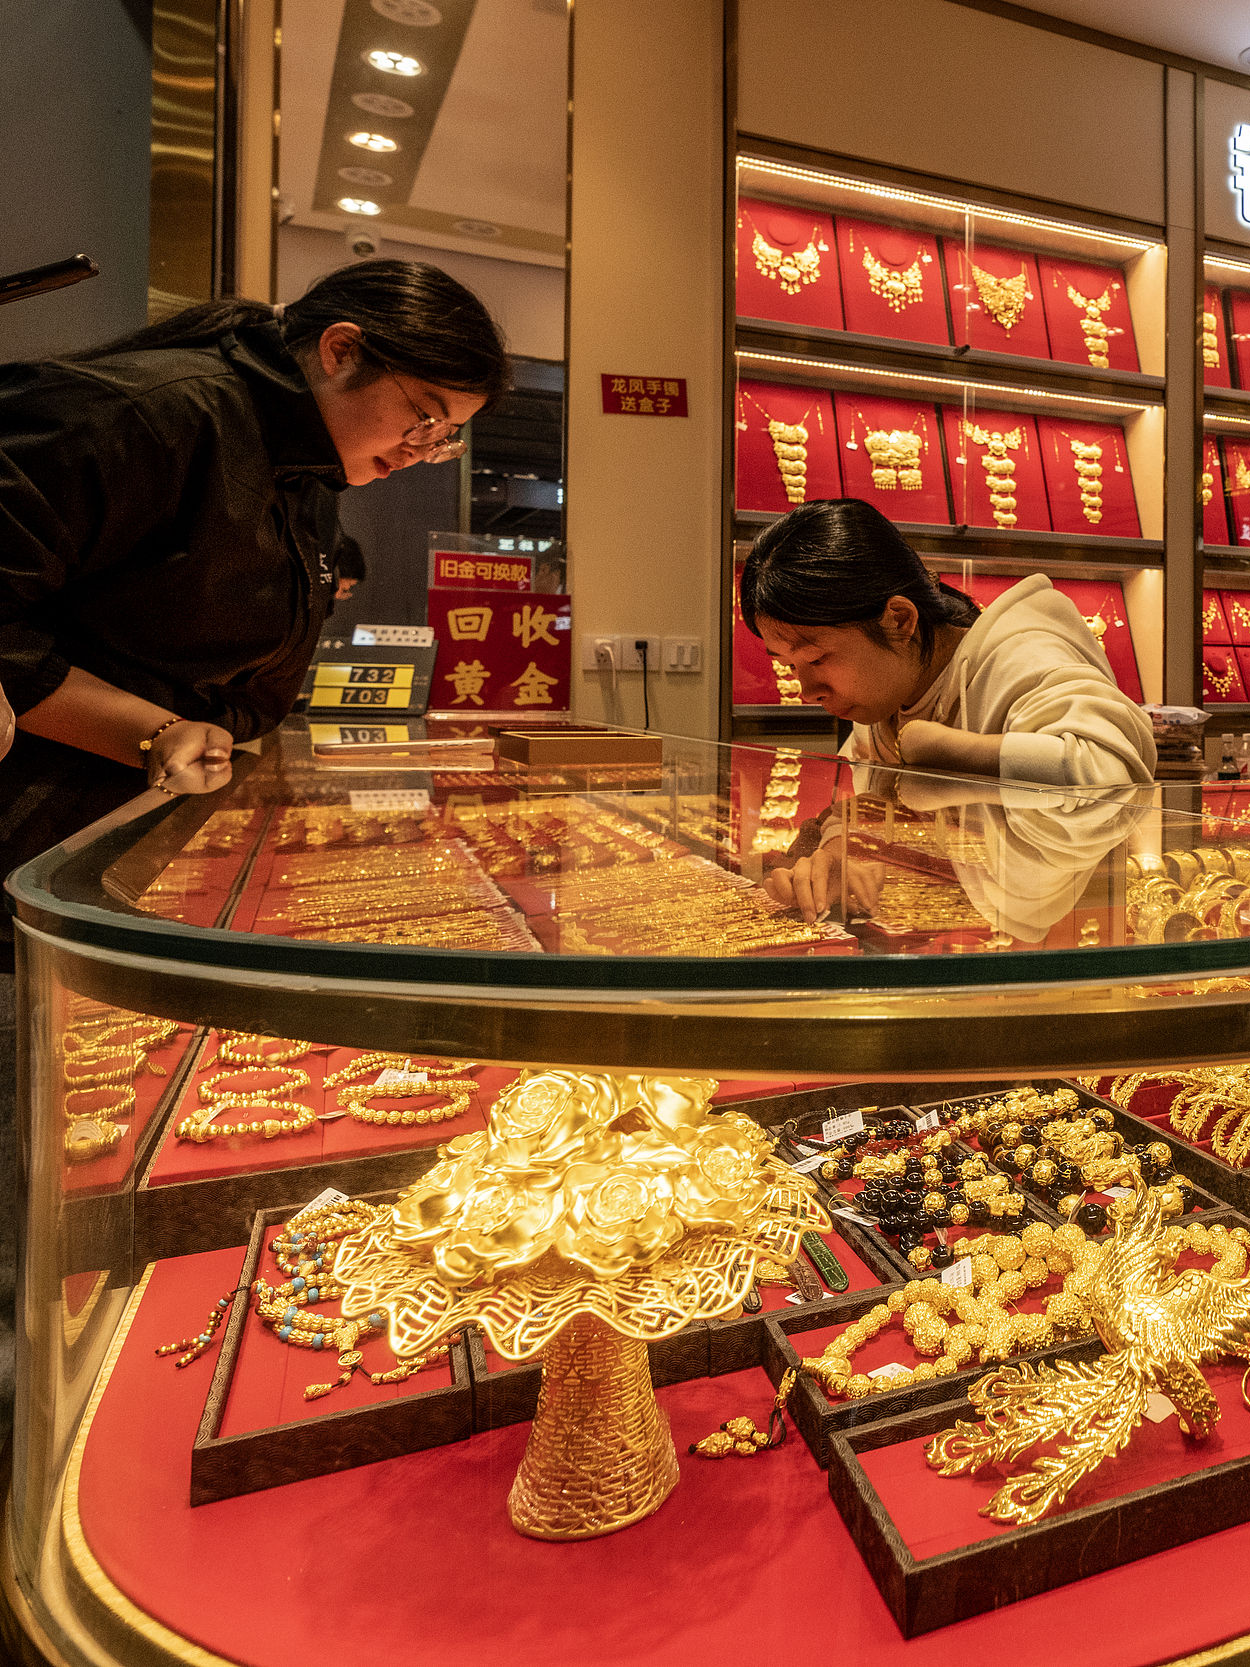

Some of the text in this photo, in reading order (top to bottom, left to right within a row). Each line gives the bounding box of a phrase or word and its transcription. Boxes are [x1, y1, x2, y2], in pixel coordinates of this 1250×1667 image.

[611, 378, 679, 397] 龙凤手镯
[620, 396, 672, 413] 送盒子
[440, 559, 529, 582] 旧金可换款
[447, 605, 560, 648] 回收
[352, 669, 395, 682] 732
[444, 660, 559, 706] 黄金
[344, 689, 387, 703] 703
